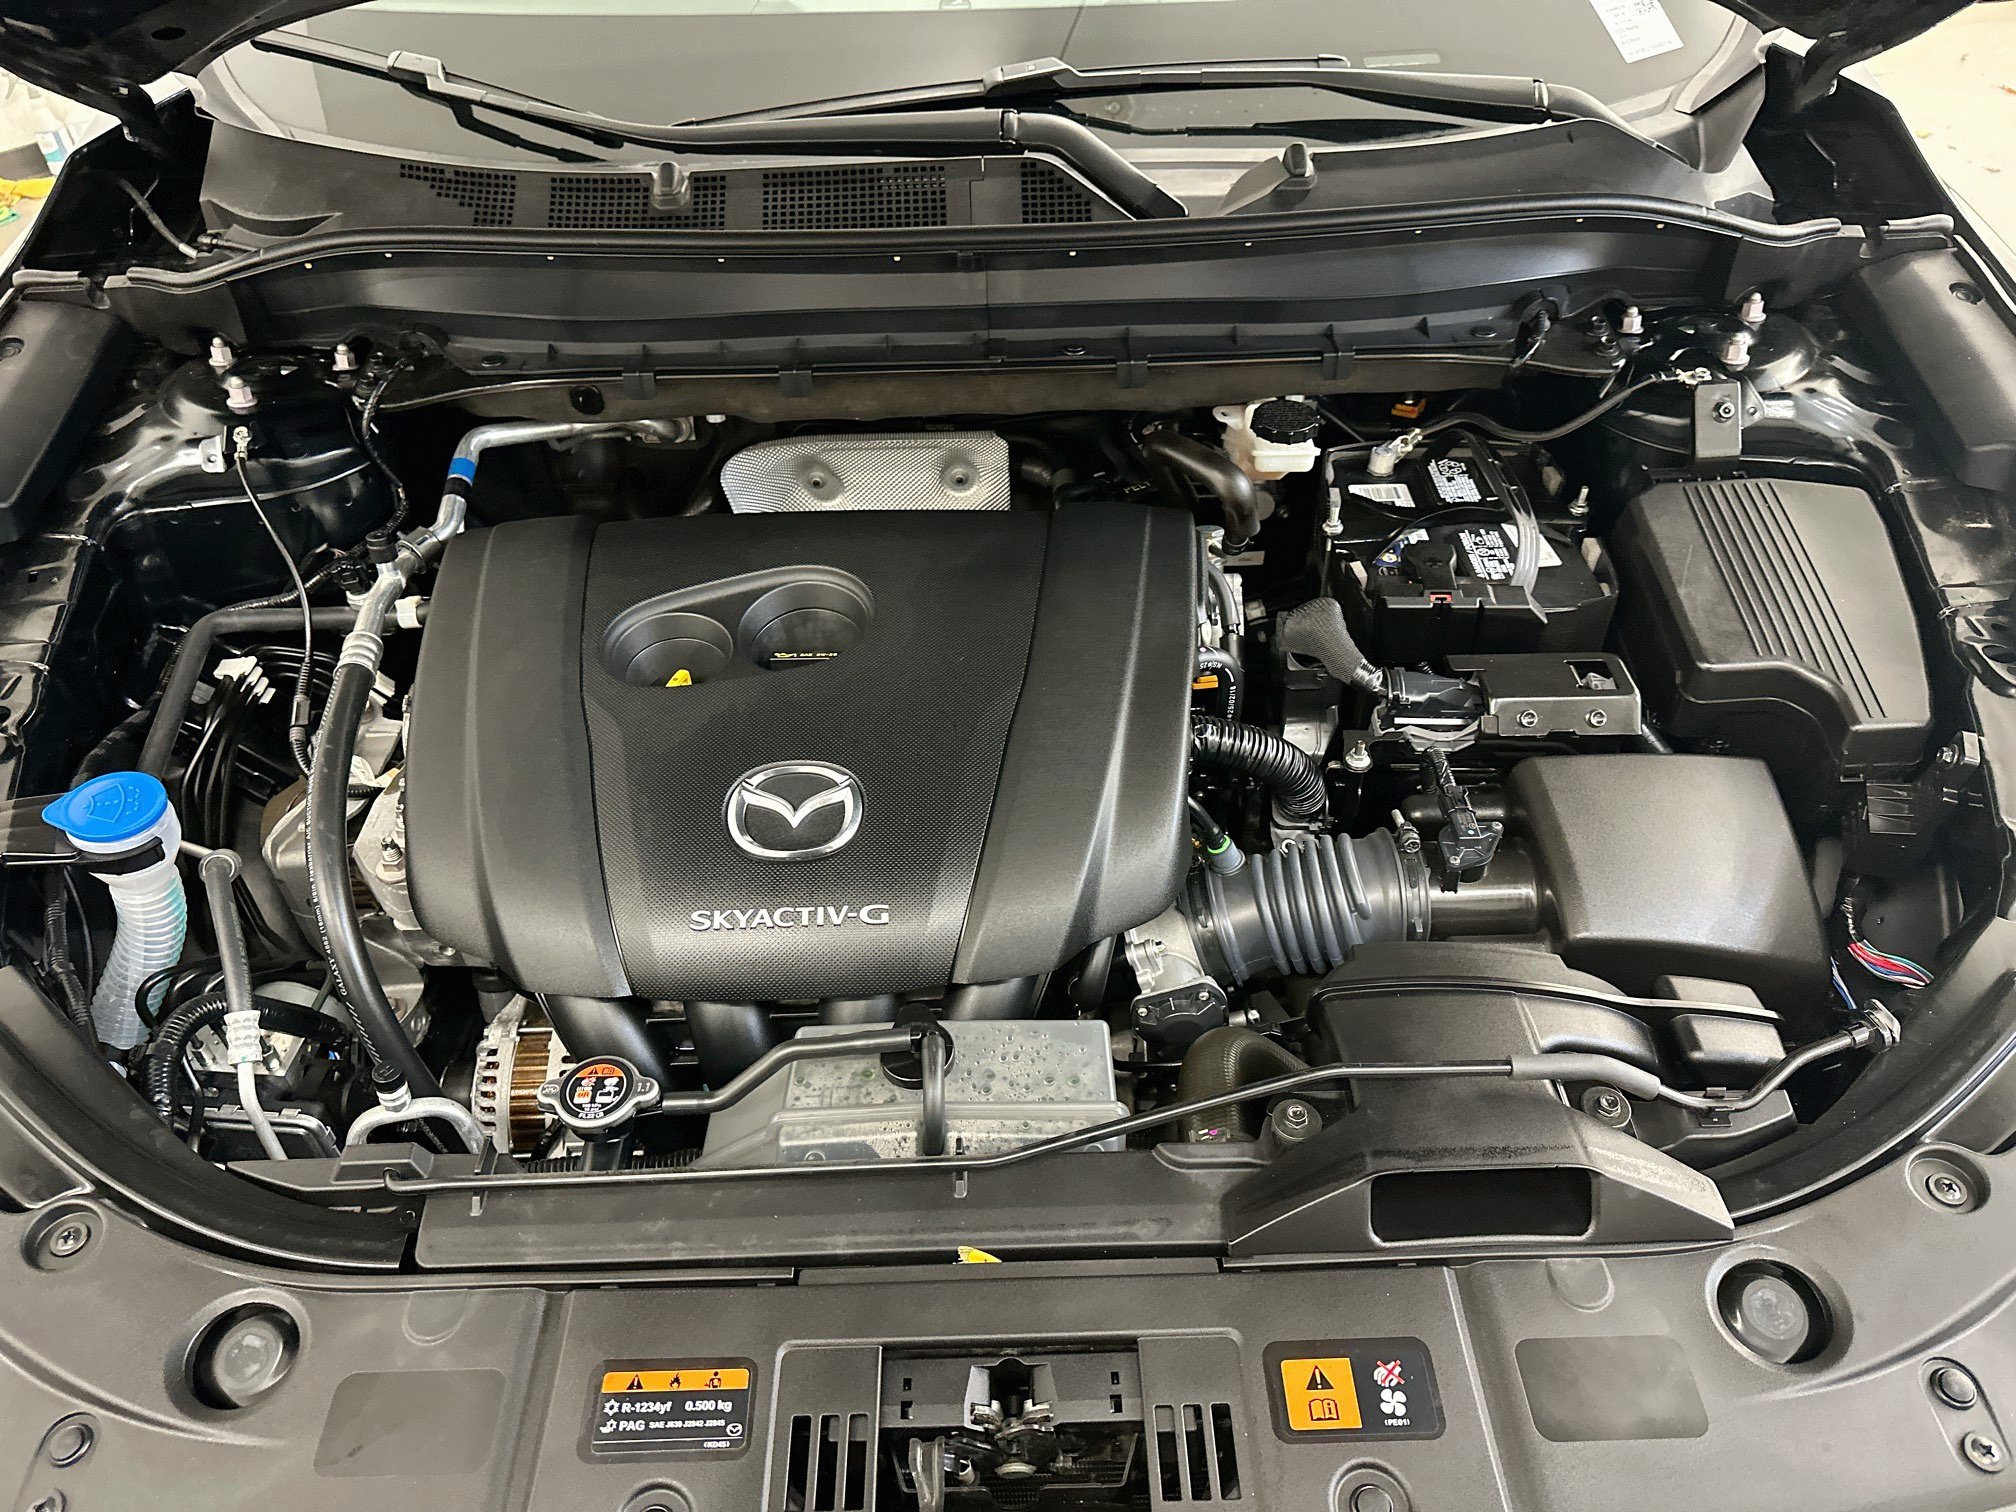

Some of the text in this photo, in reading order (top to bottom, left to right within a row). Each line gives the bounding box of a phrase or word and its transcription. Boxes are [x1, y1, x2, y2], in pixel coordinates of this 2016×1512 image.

[689, 904, 890, 931] SKYACTIV-G
[328, 957, 347, 996] GALAXY
[621, 1400, 732, 1414] R-1234yf 0.500 kg
[618, 1420, 645, 1432] PAG
[648, 1420, 664, 1429] SAE
